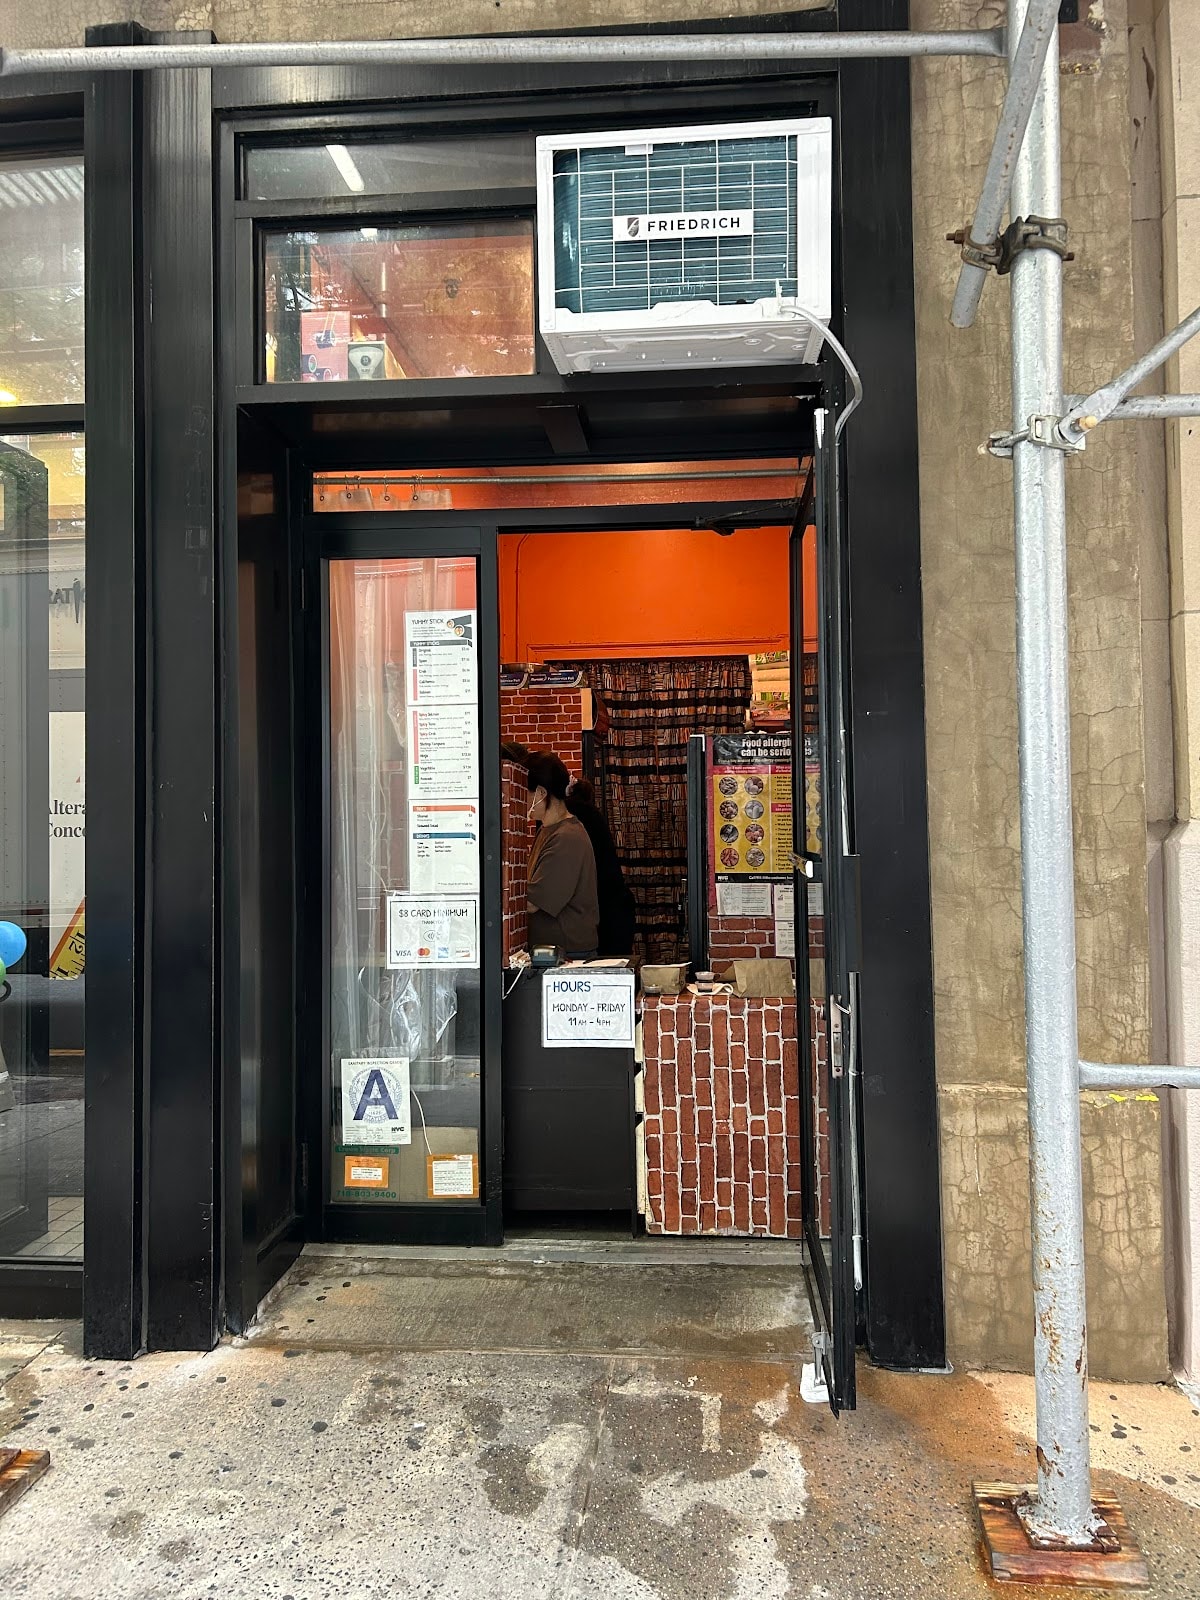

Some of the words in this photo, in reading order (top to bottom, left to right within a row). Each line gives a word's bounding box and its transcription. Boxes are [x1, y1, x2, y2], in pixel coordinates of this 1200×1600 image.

[647, 217, 740, 232] FRIEDRICH
[741, 738, 762, 747] Food
[763, 737, 791, 748] allergi
[741, 749, 757, 757] can
[757, 748, 769, 757] be
[769, 748, 791, 756] serio
[398, 909, 409, 918] $8
[410, 909, 432, 918] CARD
[433, 908, 468, 917] MINIMUM
[553, 980, 592, 993] HOURS
[552, 1003, 589, 1012] MONDAY
[597, 1003, 626, 1012] FRIDAY
[352, 1069, 399, 1121] A
